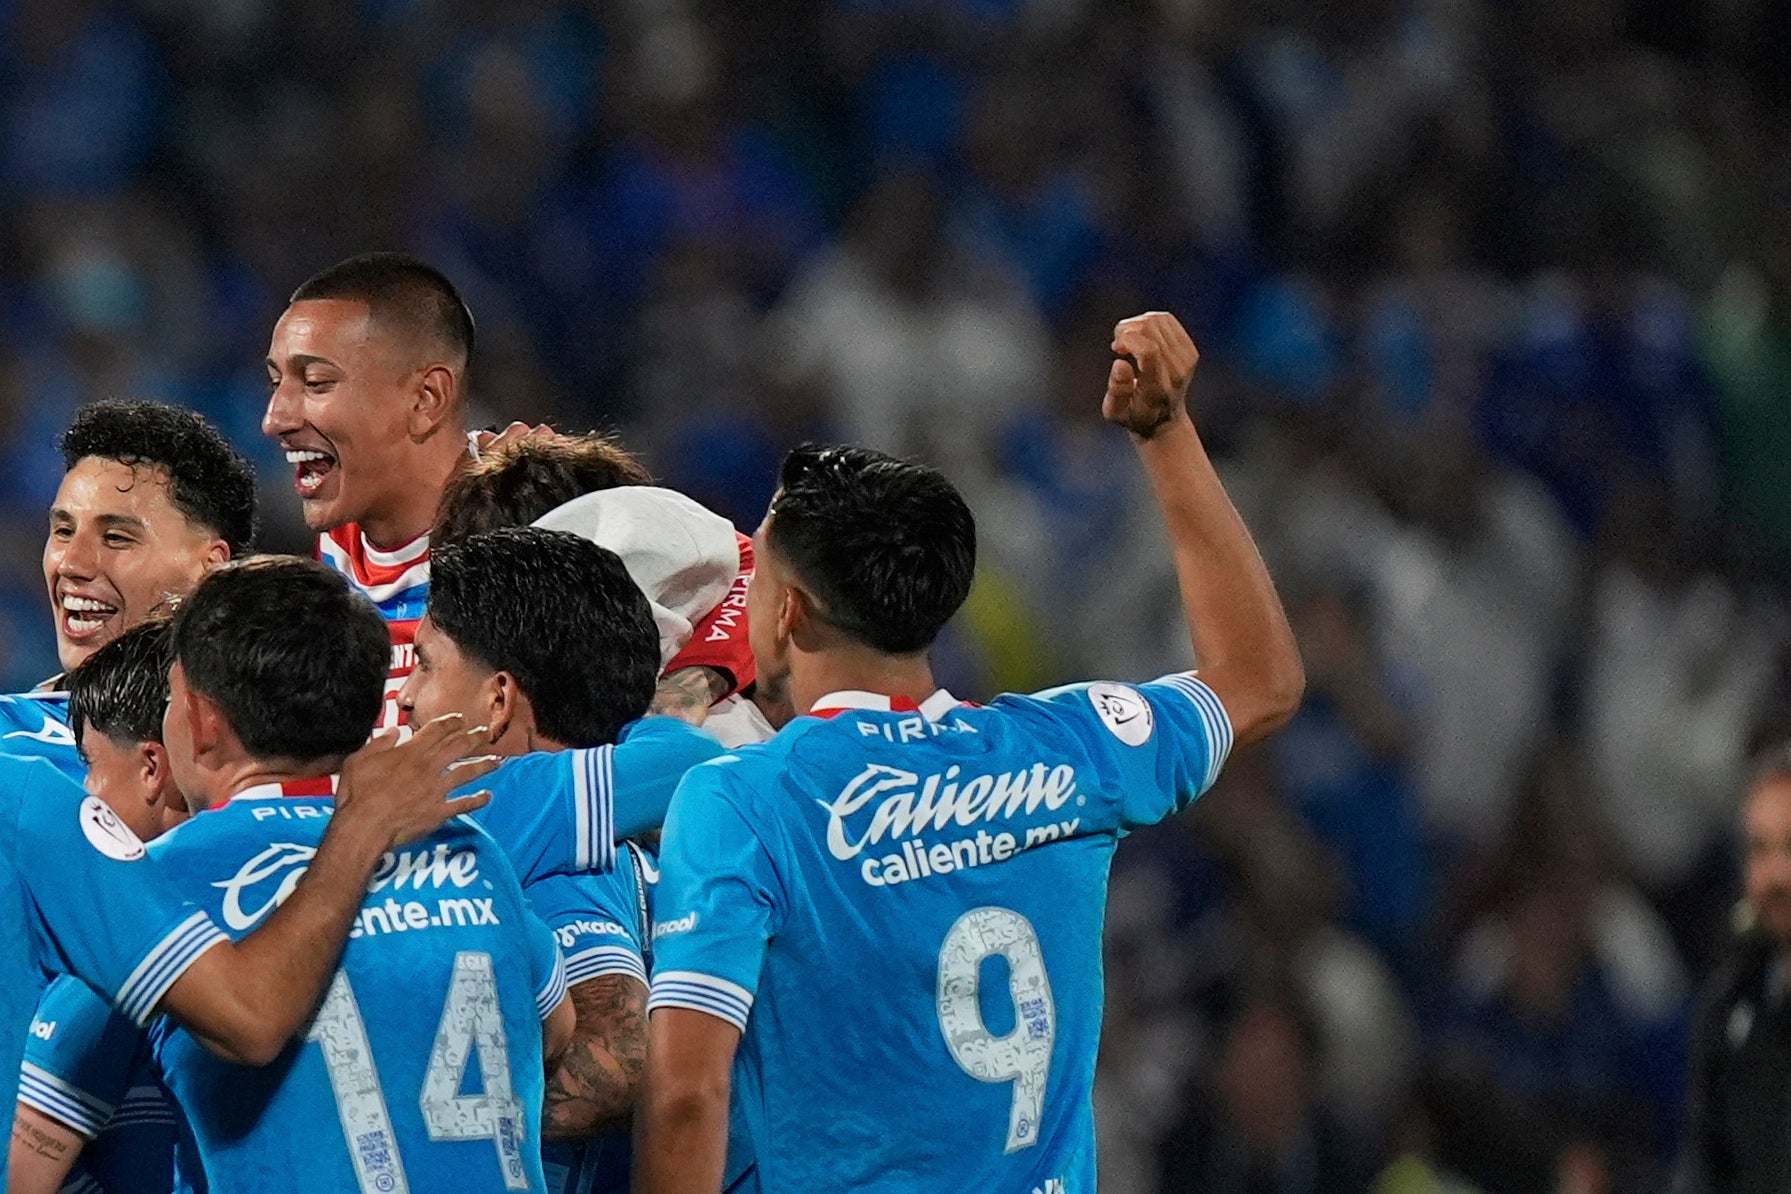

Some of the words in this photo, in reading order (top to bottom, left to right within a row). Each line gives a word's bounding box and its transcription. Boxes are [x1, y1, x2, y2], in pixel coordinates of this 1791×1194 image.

[251, 805, 336, 821] PIR
[816, 762, 1077, 861] Caliente
[936, 906, 1056, 1154] 9
